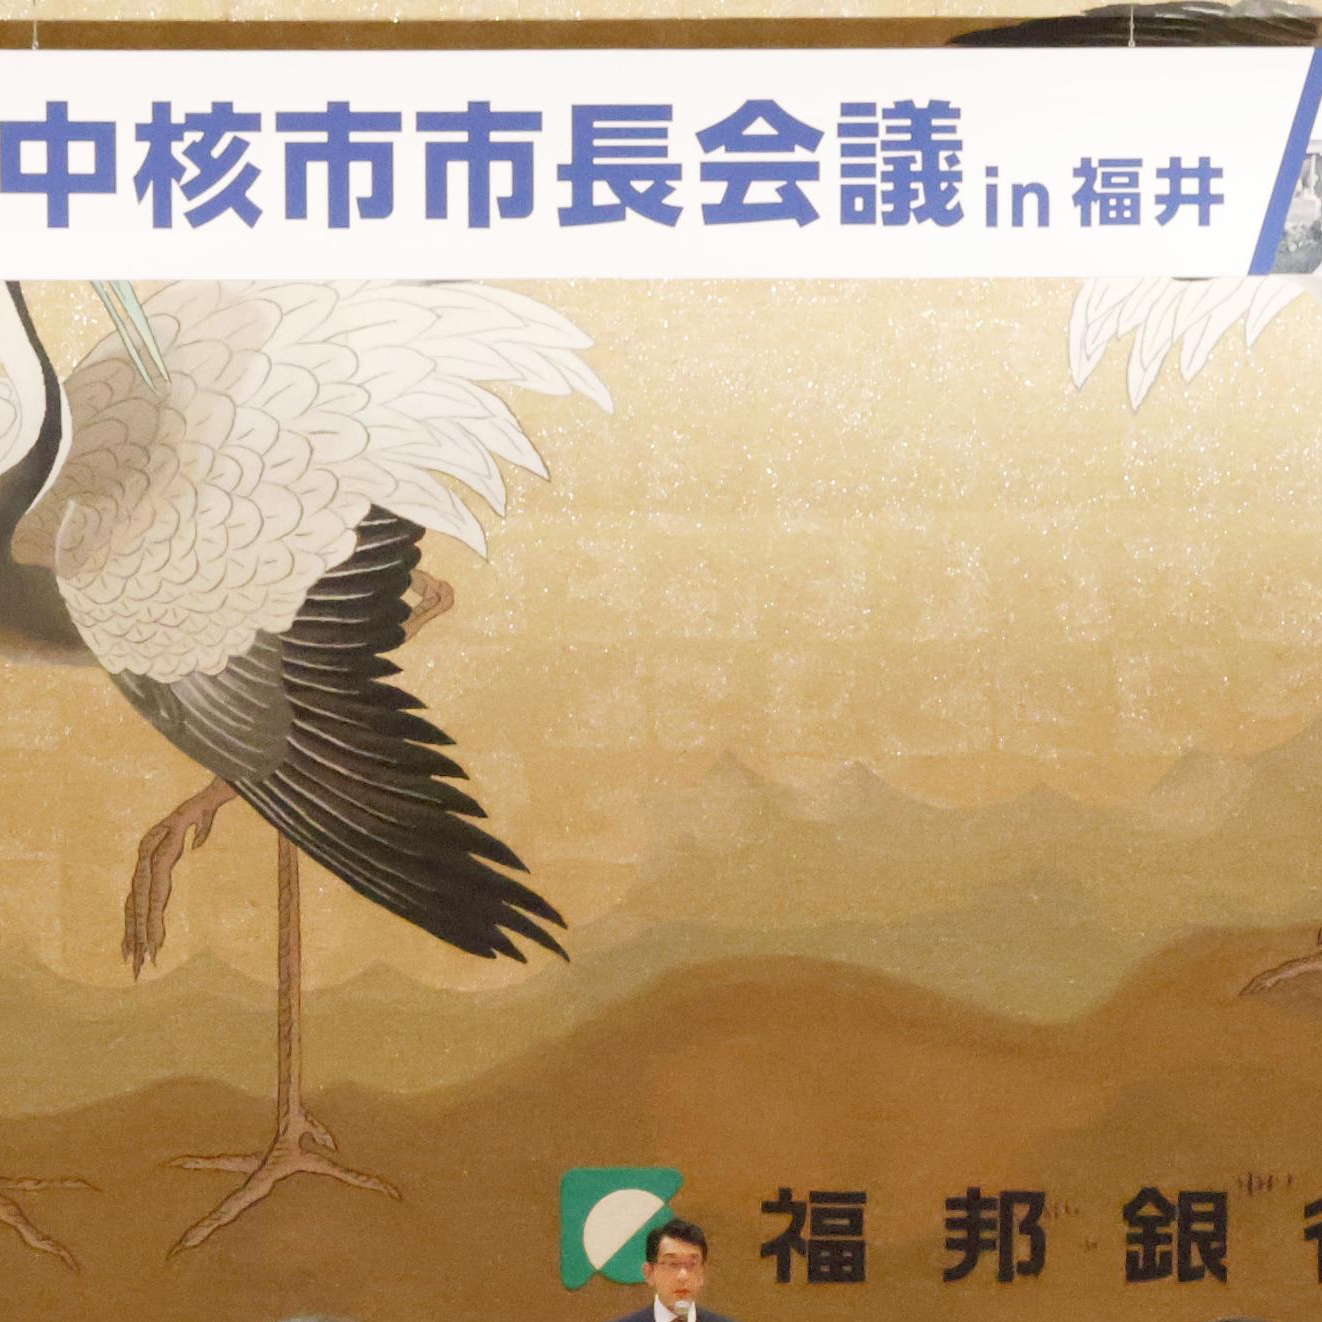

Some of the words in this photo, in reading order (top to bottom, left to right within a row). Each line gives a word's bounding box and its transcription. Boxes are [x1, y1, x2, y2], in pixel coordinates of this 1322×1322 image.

[0, 99, 963, 229] 中核市市長会議
[986, 167, 1049, 227] in
[1072, 158, 1223, 226] 福井
